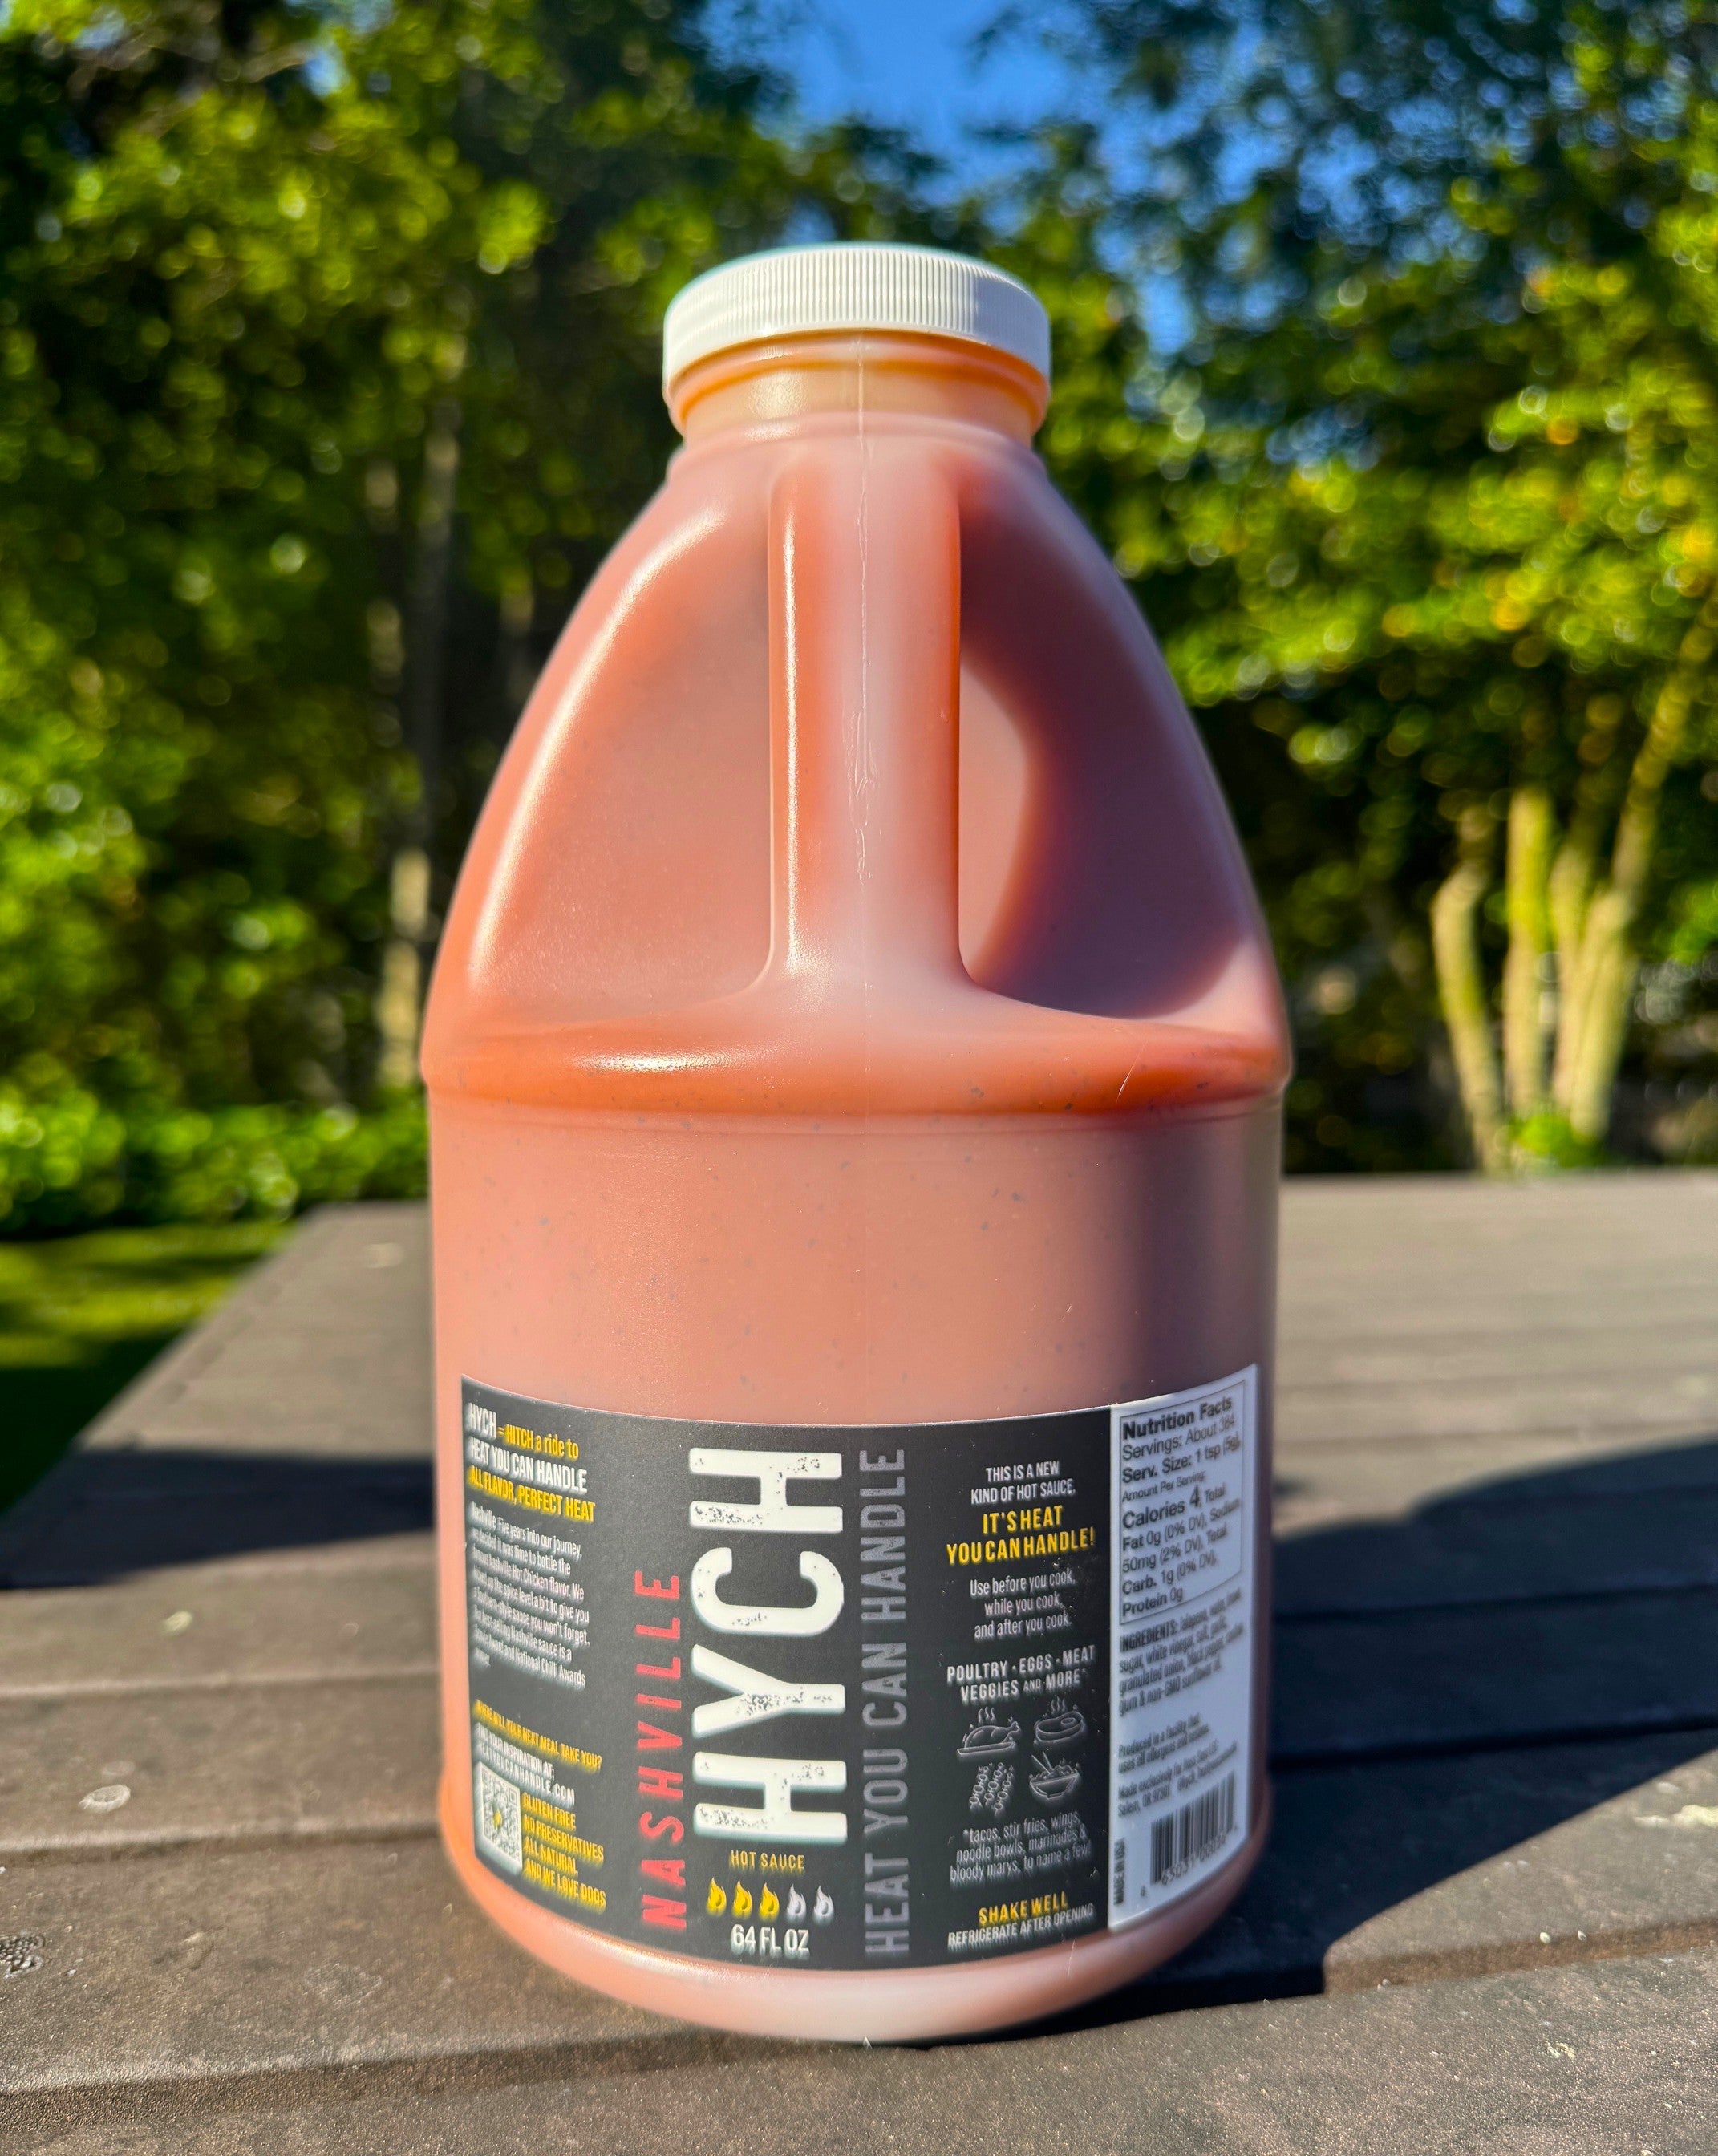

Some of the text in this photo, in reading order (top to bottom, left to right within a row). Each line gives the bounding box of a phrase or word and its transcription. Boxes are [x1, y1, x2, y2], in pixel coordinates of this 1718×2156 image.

[467, 1404, 579, 1460] HYCH HITCH a ride to
[1124, 1396, 1232, 1440] Nutrition Facts
[1123, 1436, 1182, 1460] Servings:
[1185, 1423, 1217, 1444] About
[469, 1437, 587, 1493] HEAT YOU CAN HANDLE
[986, 1461, 1060, 1481] THIS IS A NEW
[1123, 1465, 1157, 1483] Serv.
[1162, 1455, 1191, 1473] Size:
[1196, 1448, 1201, 1462] 1
[1205, 1445, 1220, 1460] tsp
[469, 1465, 595, 1522] ALL FLAVOR, PERFECT HEAT
[971, 1488, 998, 1504] KIND
[1001, 1486, 1014, 1502] OF
[1017, 1484, 1037, 1499] HOT
[1123, 1485, 1157, 1502] Amount
[1161, 1481, 1173, 1492] Per
[1123, 1500, 1185, 1528] Calories
[1205, 1485, 1225, 1502] Total
[983, 1505, 1063, 1534] IT'S HEAT
[526, 1528, 540, 1545] into
[541, 1535, 553, 1549] our
[553, 1535, 582, 1561] journey,
[946, 1527, 1095, 1565] YOU CAN HANDLE!
[1123, 1536, 1143, 1551] Fat
[1146, 1531, 1160, 1546] 0g
[1165, 1522, 1185, 1542] (0%
[1123, 1554, 1156, 1573] 50mg
[1160, 1543, 1180, 1566] (2%
[1206, 1524, 1227, 1542] Total
[515, 1545, 571, 1575] time to bottle the
[523, 1568, 584, 1599] Chicken flavor. We
[970, 1579, 990, 1595] Use
[993, 1576, 1027, 1593] before
[1029, 1574, 1047, 1592] you
[1124, 1576, 1157, 1595] Carb.
[1161, 1570, 1173, 1584] 1g
[533, 1595, 539, 1607] a
[539, 1595, 549, 1612] bit
[549, 1599, 557, 1614] to
[558, 1603, 573, 1620] give
[575, 1608, 589, 1626] you
[984, 1598, 1012, 1616] while
[1016, 1597, 1033, 1615] you
[1124, 1588, 1183, 1616] Protein 0g
[531, 1615, 589, 1647] you won't forget.
[974, 1621, 994, 1639] and
[997, 1619, 1023, 1635] after
[1026, 1617, 1043, 1635] you
[1120, 1619, 1177, 1652] INGREDIENTS:
[539, 1639, 572, 1661] sauce a
[690, 1448, 848, 1843] HYCH
[1146, 1645, 1167, 1664] white
[560, 1664, 585, 1686] Awards
[947, 1645, 1095, 1681] POULTRY EGGS MEAT
[860, 1449, 909, 1953] HEAT YOU CAN HANDLE
[961, 1680, 1019, 1701] VEGGIES
[1023, 1679, 1041, 1692] AND
[1120, 1696, 1137, 1716] gum
[504, 1737, 542, 1773] INSPIRATION
[507, 1719, 602, 1770] YOUR NEXT MEAL TAKE YOU?
[634, 1570, 687, 1929] NASHVILLE
[523, 1792, 576, 1830] GLUTEN FREE
[523, 1814, 603, 1861] NO PRESERVATIVES
[957, 1824, 1088, 1862] noodle bowls, marinades &
[1004, 1822, 1021, 1839] stir
[524, 1837, 577, 1875] ALL NATURAL
[730, 1850, 804, 1871] HOT SAUCE
[950, 1865, 984, 1882] bloody
[1024, 1855, 1033, 1868] to
[1036, 1850, 1061, 1866] name
[1064, 1849, 1069, 1860] a
[525, 1858, 606, 1907] AND WE LOVE DOGS
[979, 1891, 1068, 1924] SHAKE WELL
[731, 1924, 809, 1956] 64 FL OZ
[948, 1903, 1093, 1947] REFRIGERATE AFTER OPENING
